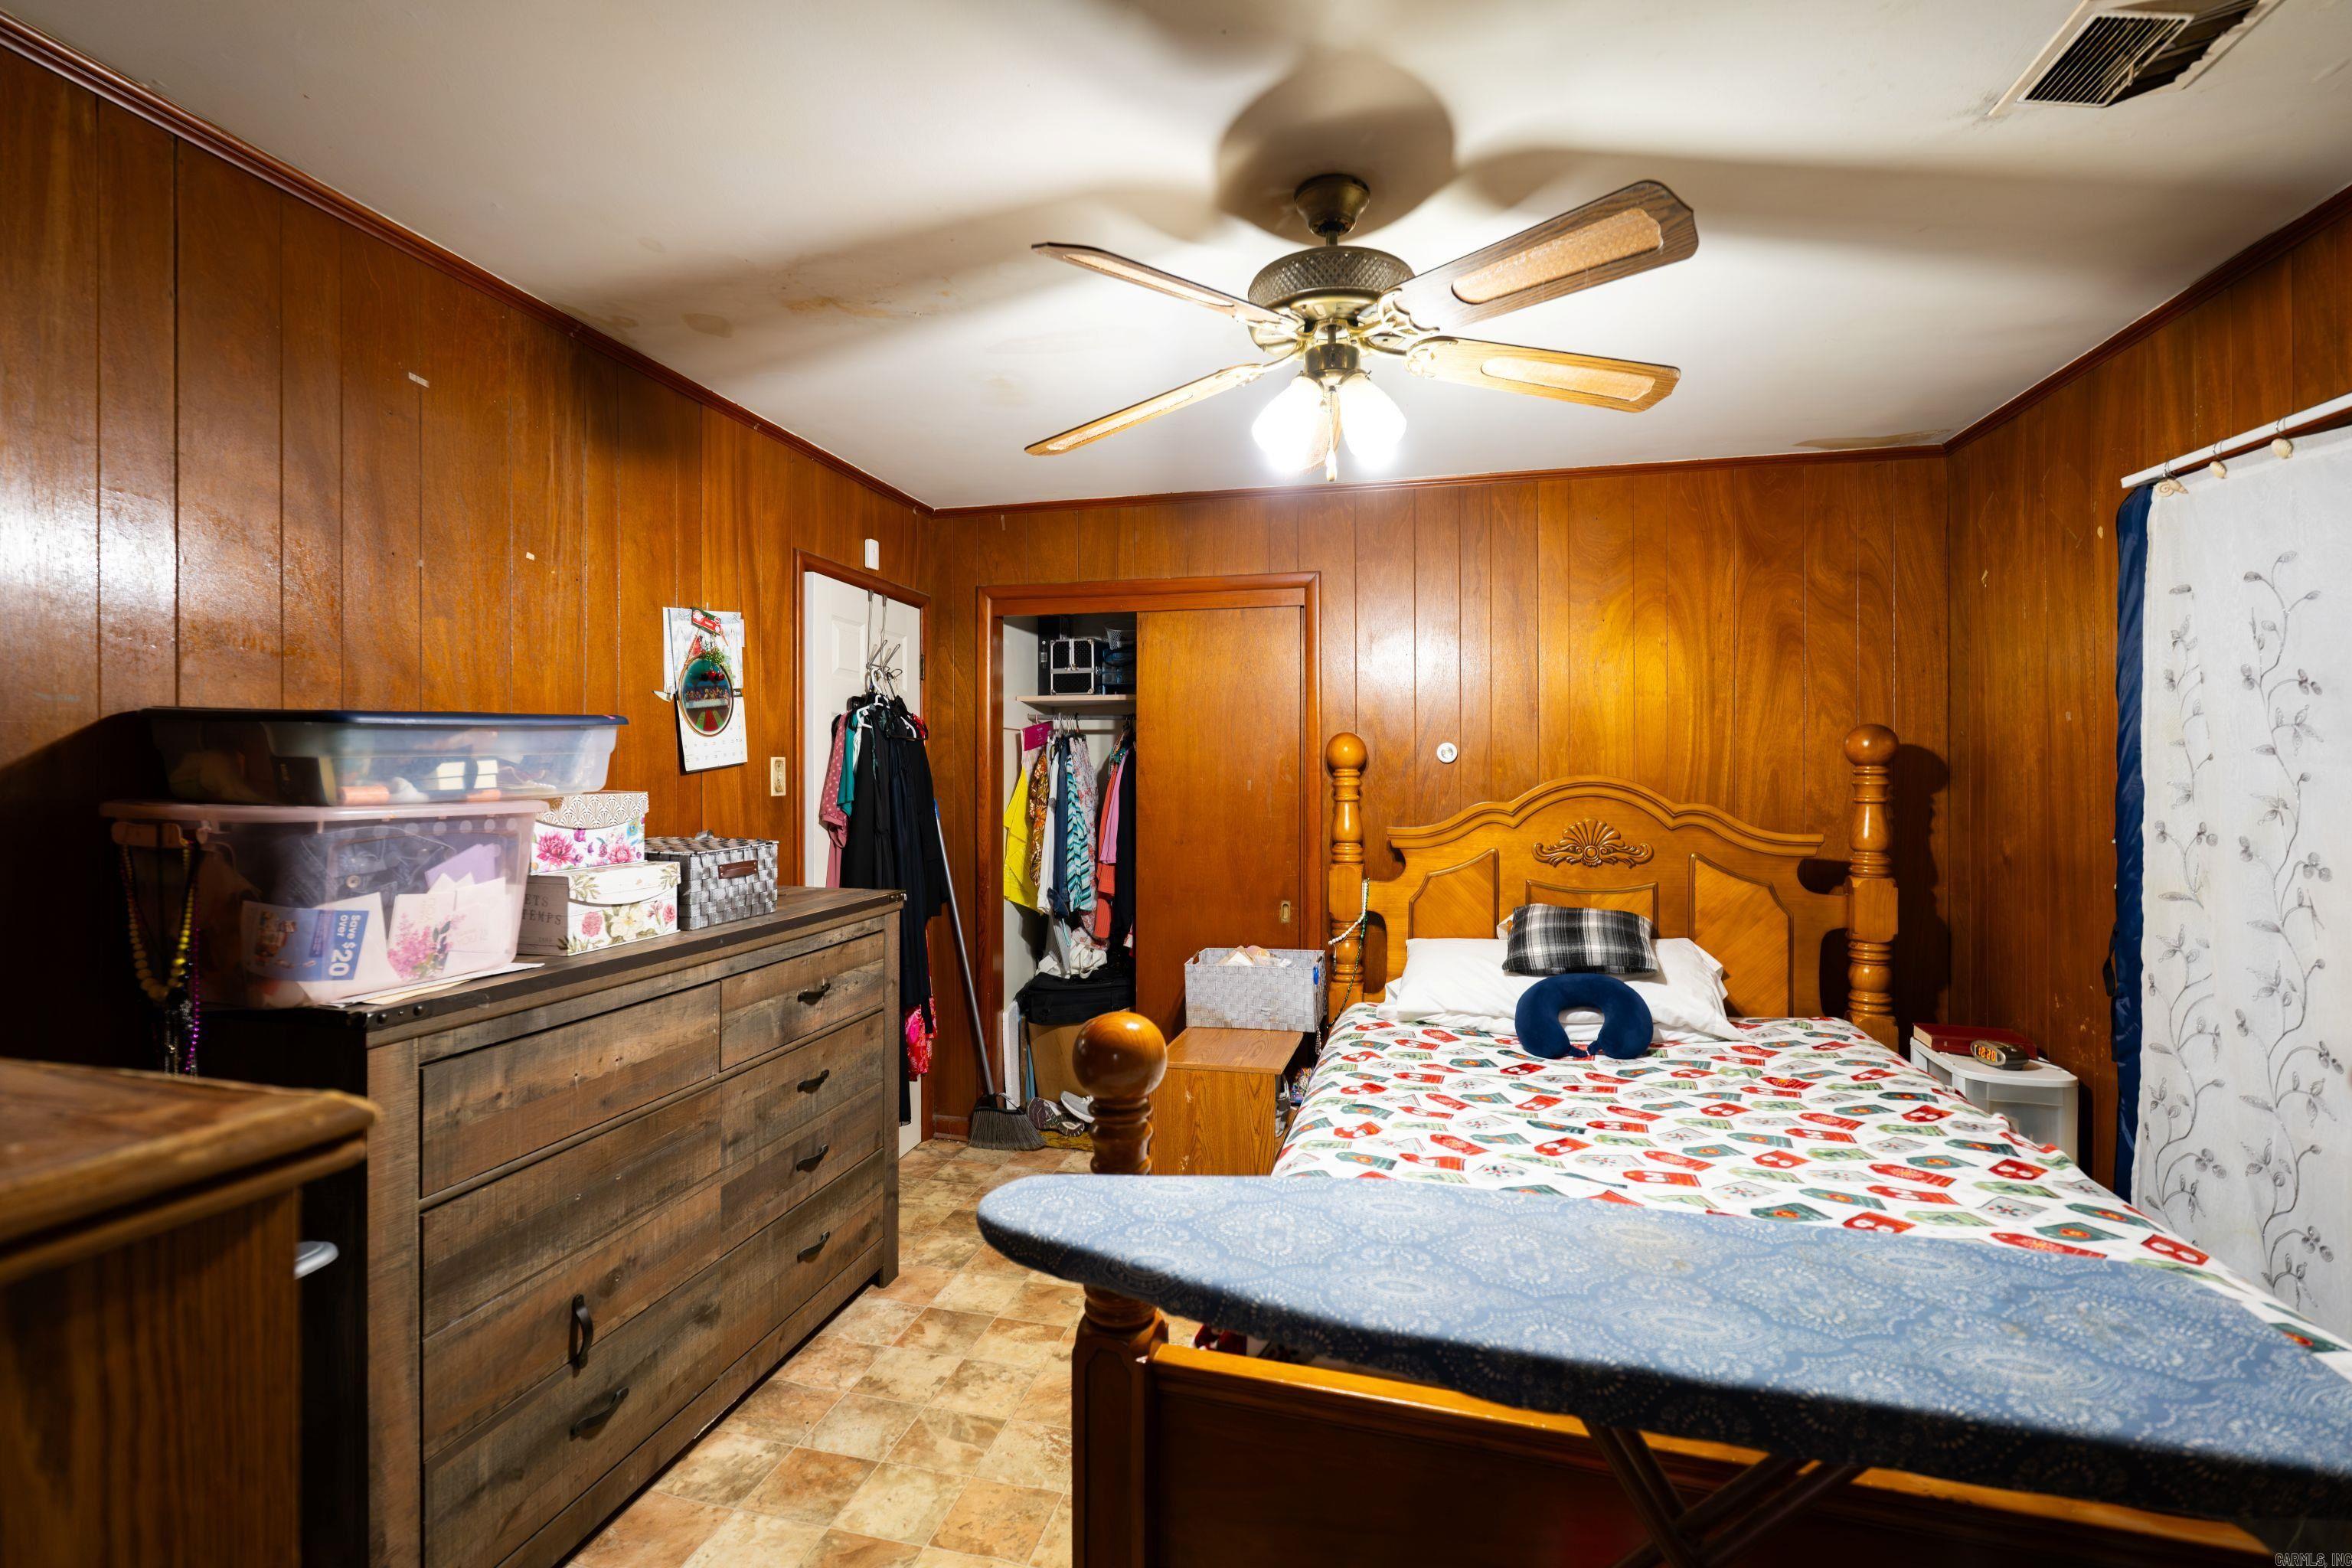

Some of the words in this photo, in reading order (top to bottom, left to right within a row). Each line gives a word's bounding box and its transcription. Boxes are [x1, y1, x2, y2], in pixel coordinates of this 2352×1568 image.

[337, 914, 350, 937] over
[347, 914, 361, 939] Save
[328, 942, 358, 976] $20
